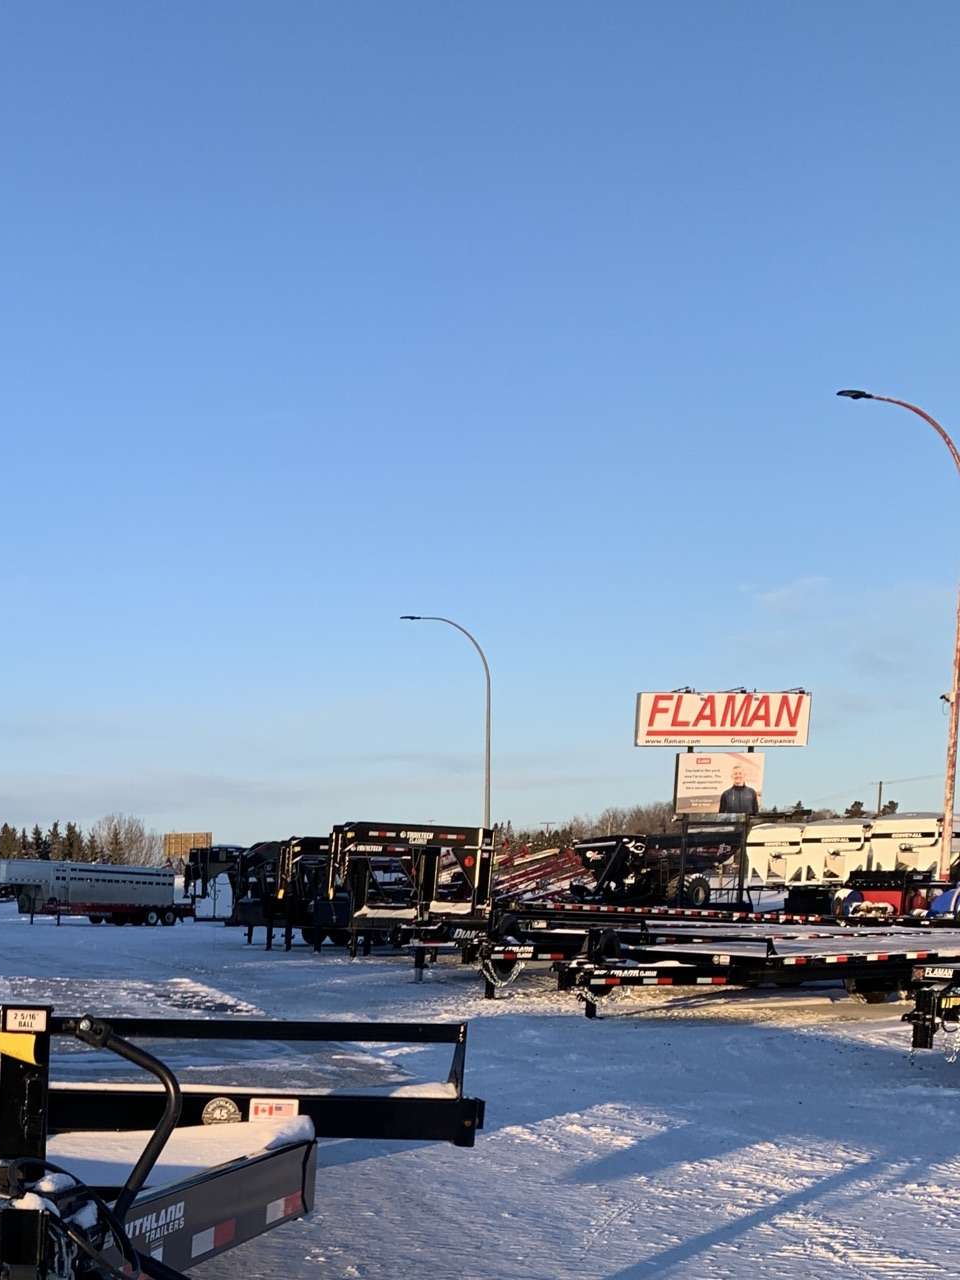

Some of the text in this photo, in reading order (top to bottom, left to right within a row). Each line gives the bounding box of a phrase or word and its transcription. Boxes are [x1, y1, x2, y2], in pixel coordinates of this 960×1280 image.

[648, 694, 804, 728] FLAMAN
[730, 737, 751, 746] Group
[925, 967, 954, 978] FLAMAN
[13, 1012, 18, 1020] 2
[18, 1020, 33, 1028] BALL
[145, 1217, 185, 1244] TRAILERS
